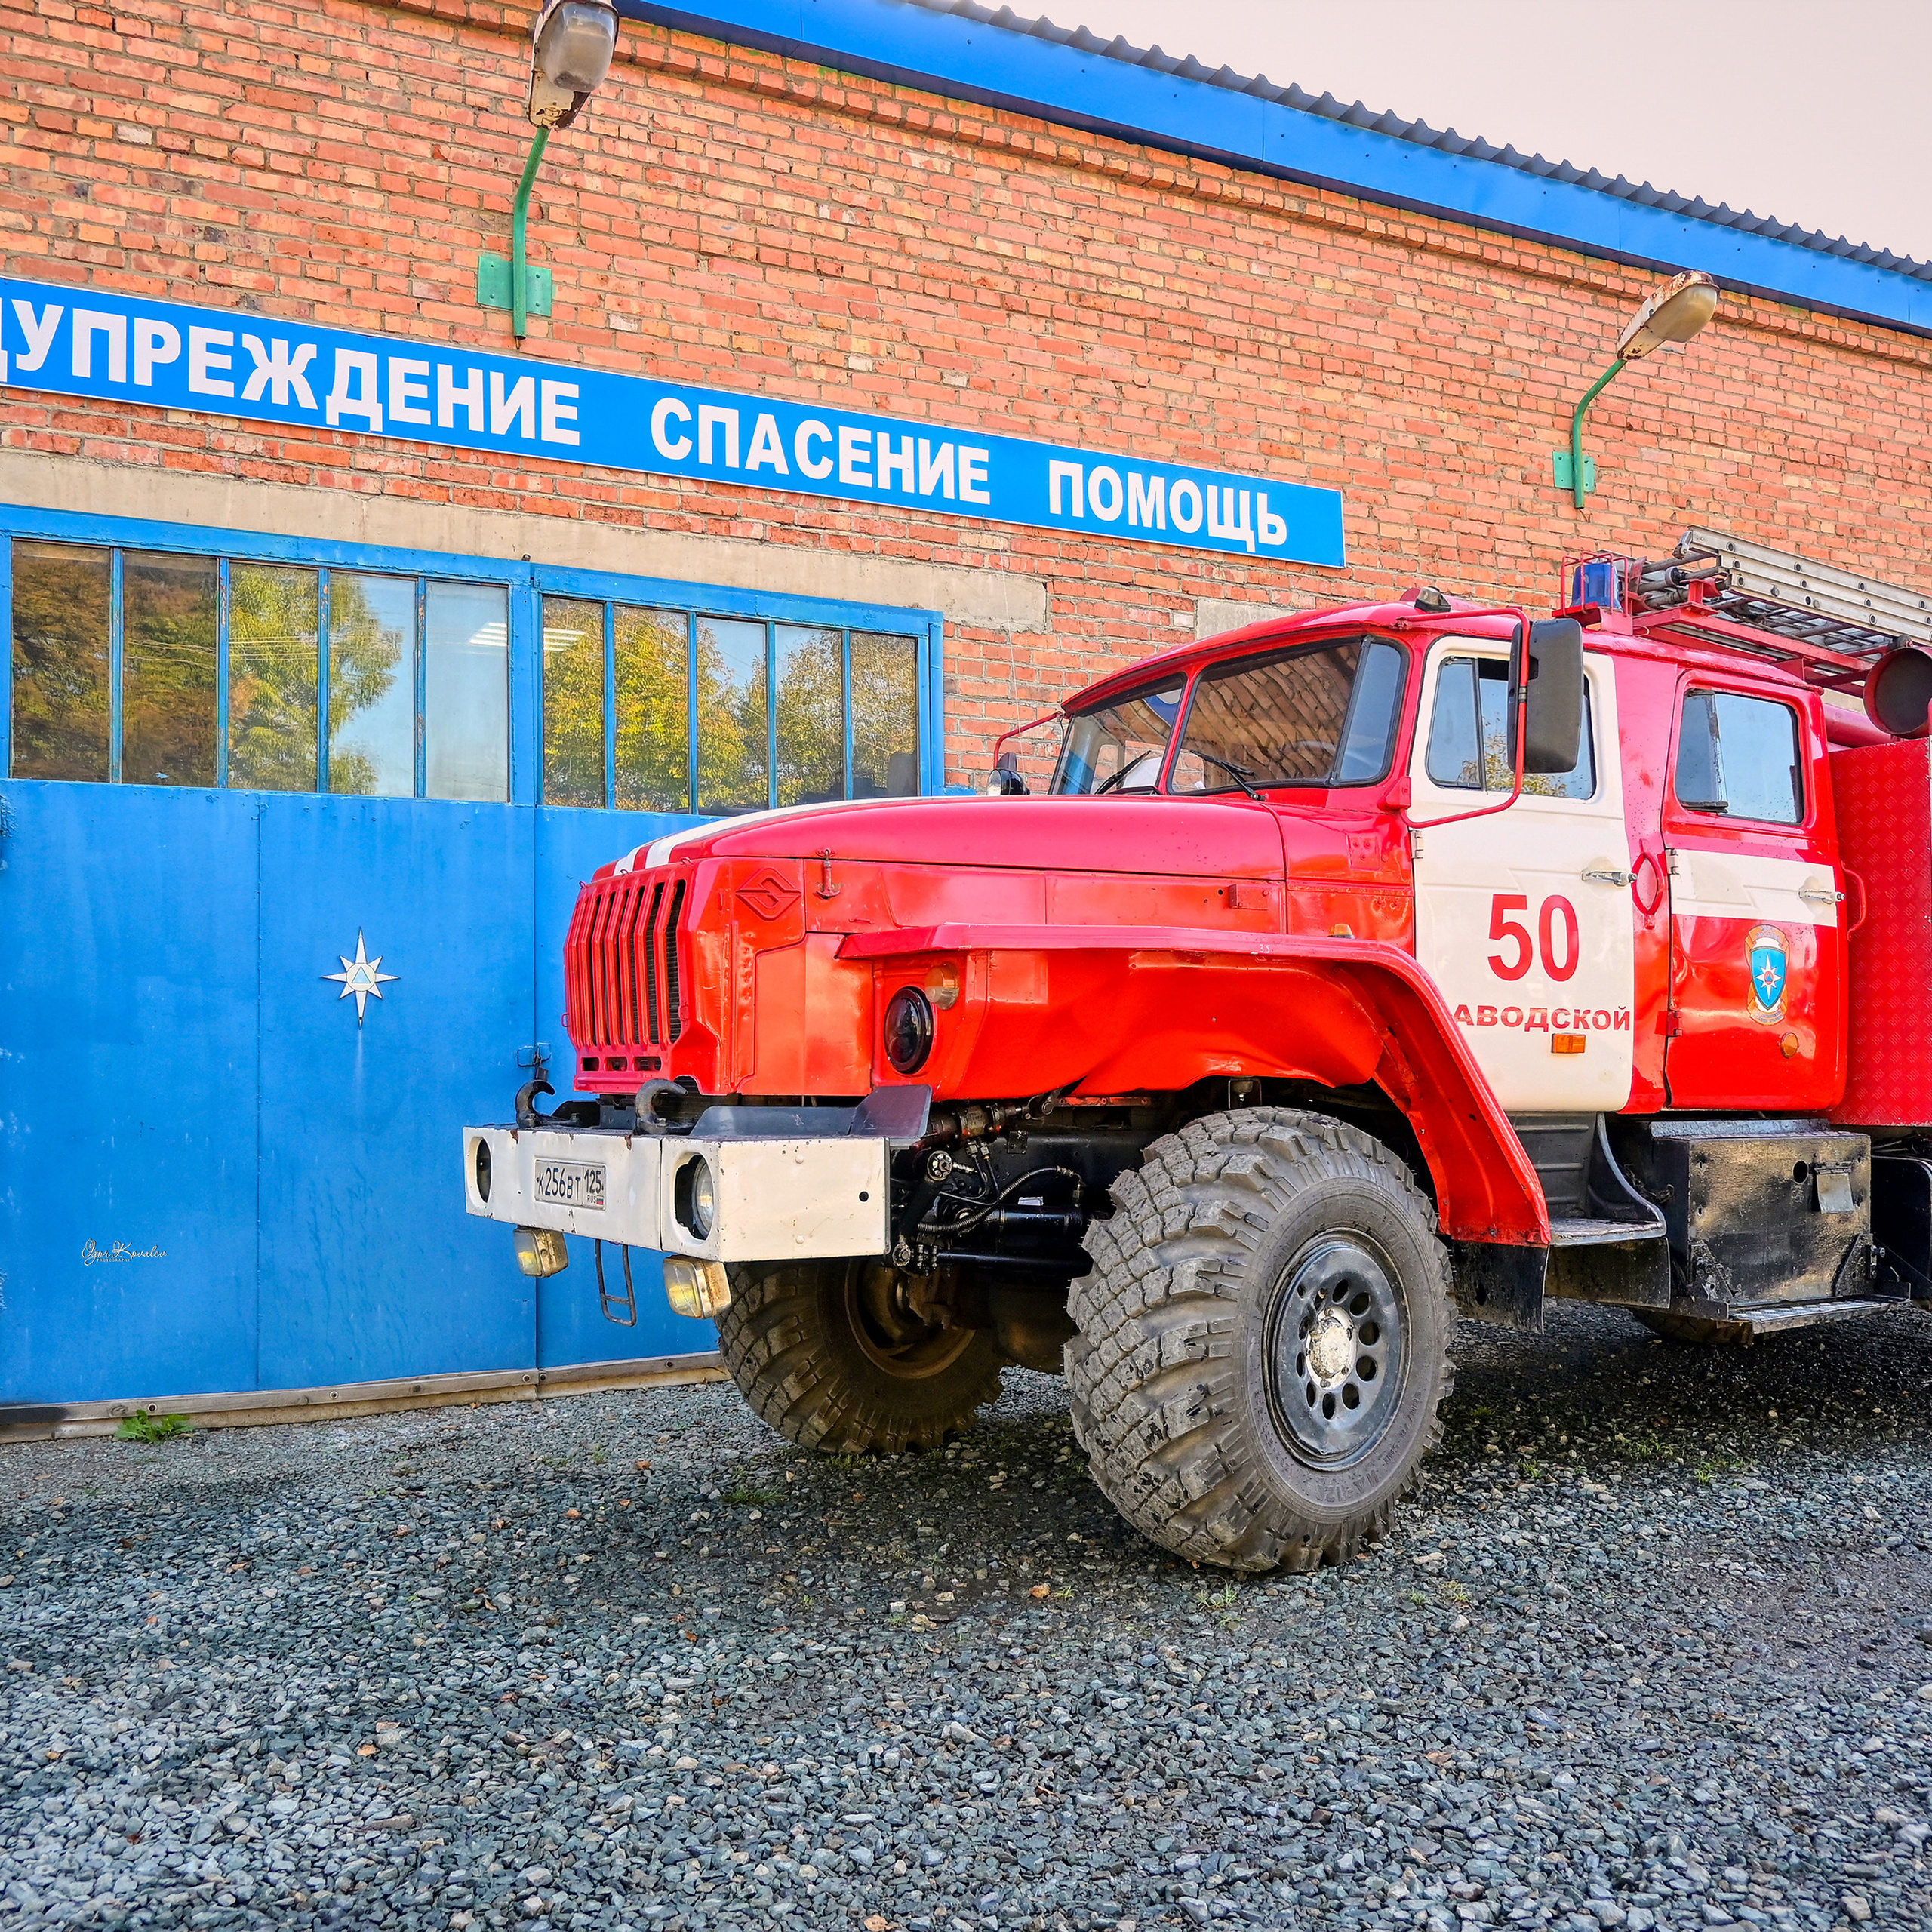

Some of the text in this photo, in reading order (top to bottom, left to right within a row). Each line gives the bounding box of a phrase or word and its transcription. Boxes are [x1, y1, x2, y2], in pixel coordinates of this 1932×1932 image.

[650, 397, 991, 505] СПАСЕНИЕ
[1048, 459, 1287, 552] ПОМОЩЬ
[1487, 893, 1580, 982] 50
[584, 1169, 602, 1194] 125
